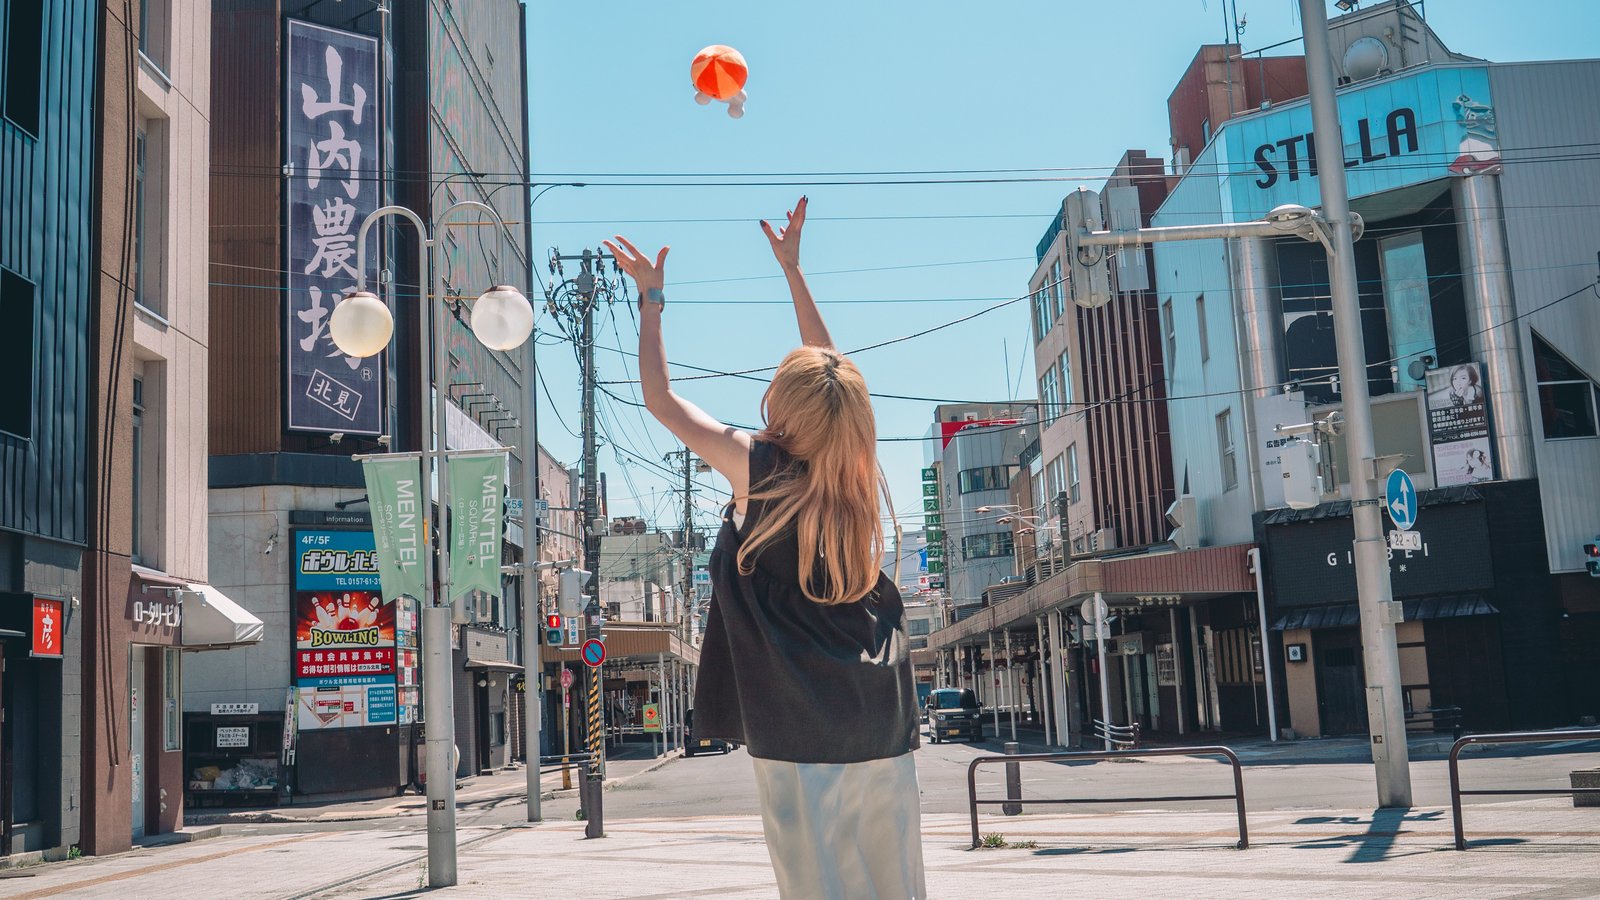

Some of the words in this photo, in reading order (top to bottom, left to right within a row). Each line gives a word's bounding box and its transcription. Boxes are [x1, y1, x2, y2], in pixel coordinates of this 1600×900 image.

[1254, 107, 1419, 190] STLA
[313, 379, 351, 414] 北見
[469, 500, 478, 546] SQUARE
[479, 474, 498, 568] MEN'TEL
[926, 484, 939, 571] モスバーガー
[301, 535, 331, 545] 4F/5F
[303, 551, 380, 572] ボウル北見
[336, 578, 349, 586] TEL
[348, 577, 381, 586] 0157-61-31
[134, 602, 181, 627] ロータリービル
[311, 629, 378, 647] BOWLING
[568, 619, 578, 643] 車分離式
[302, 651, 391, 663] 新規会員募集中!
